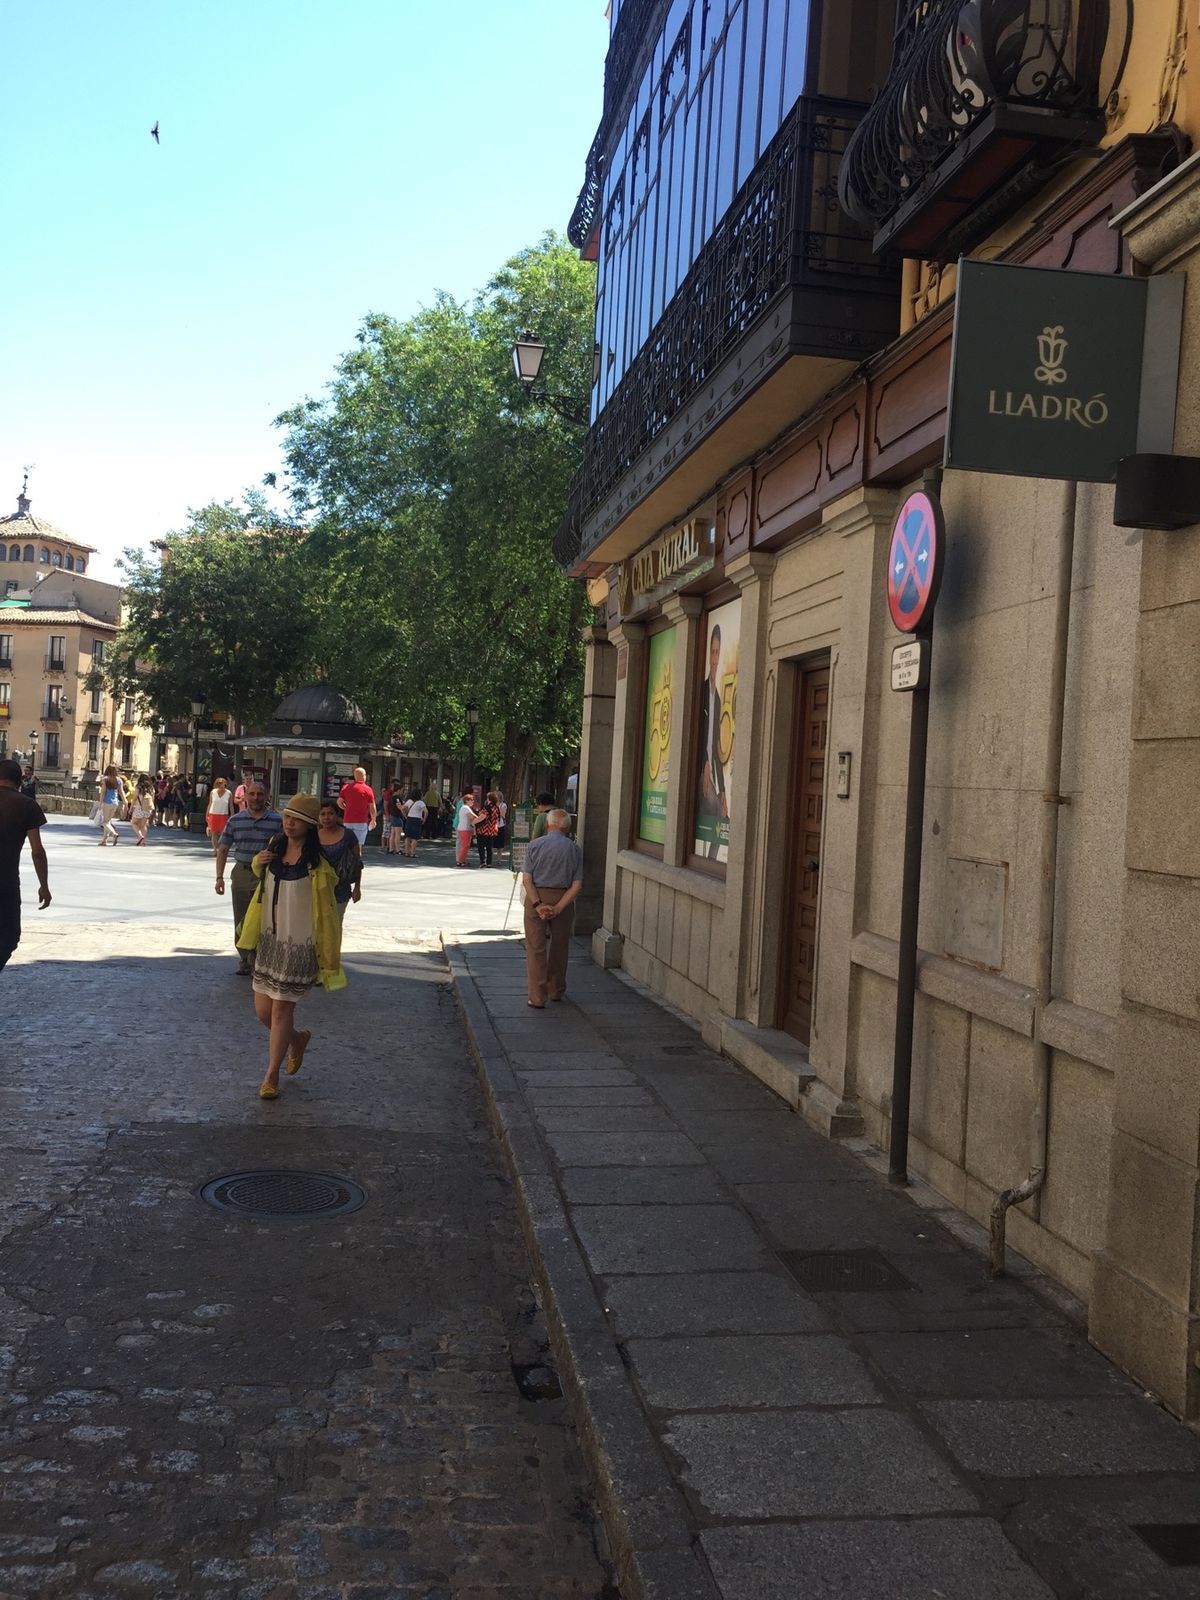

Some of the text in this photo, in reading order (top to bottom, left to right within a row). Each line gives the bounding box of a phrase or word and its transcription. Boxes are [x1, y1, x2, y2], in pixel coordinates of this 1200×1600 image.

[988, 390, 1108, 429] LLADRÓ
[631, 518, 699, 595] CAJA RURAL
